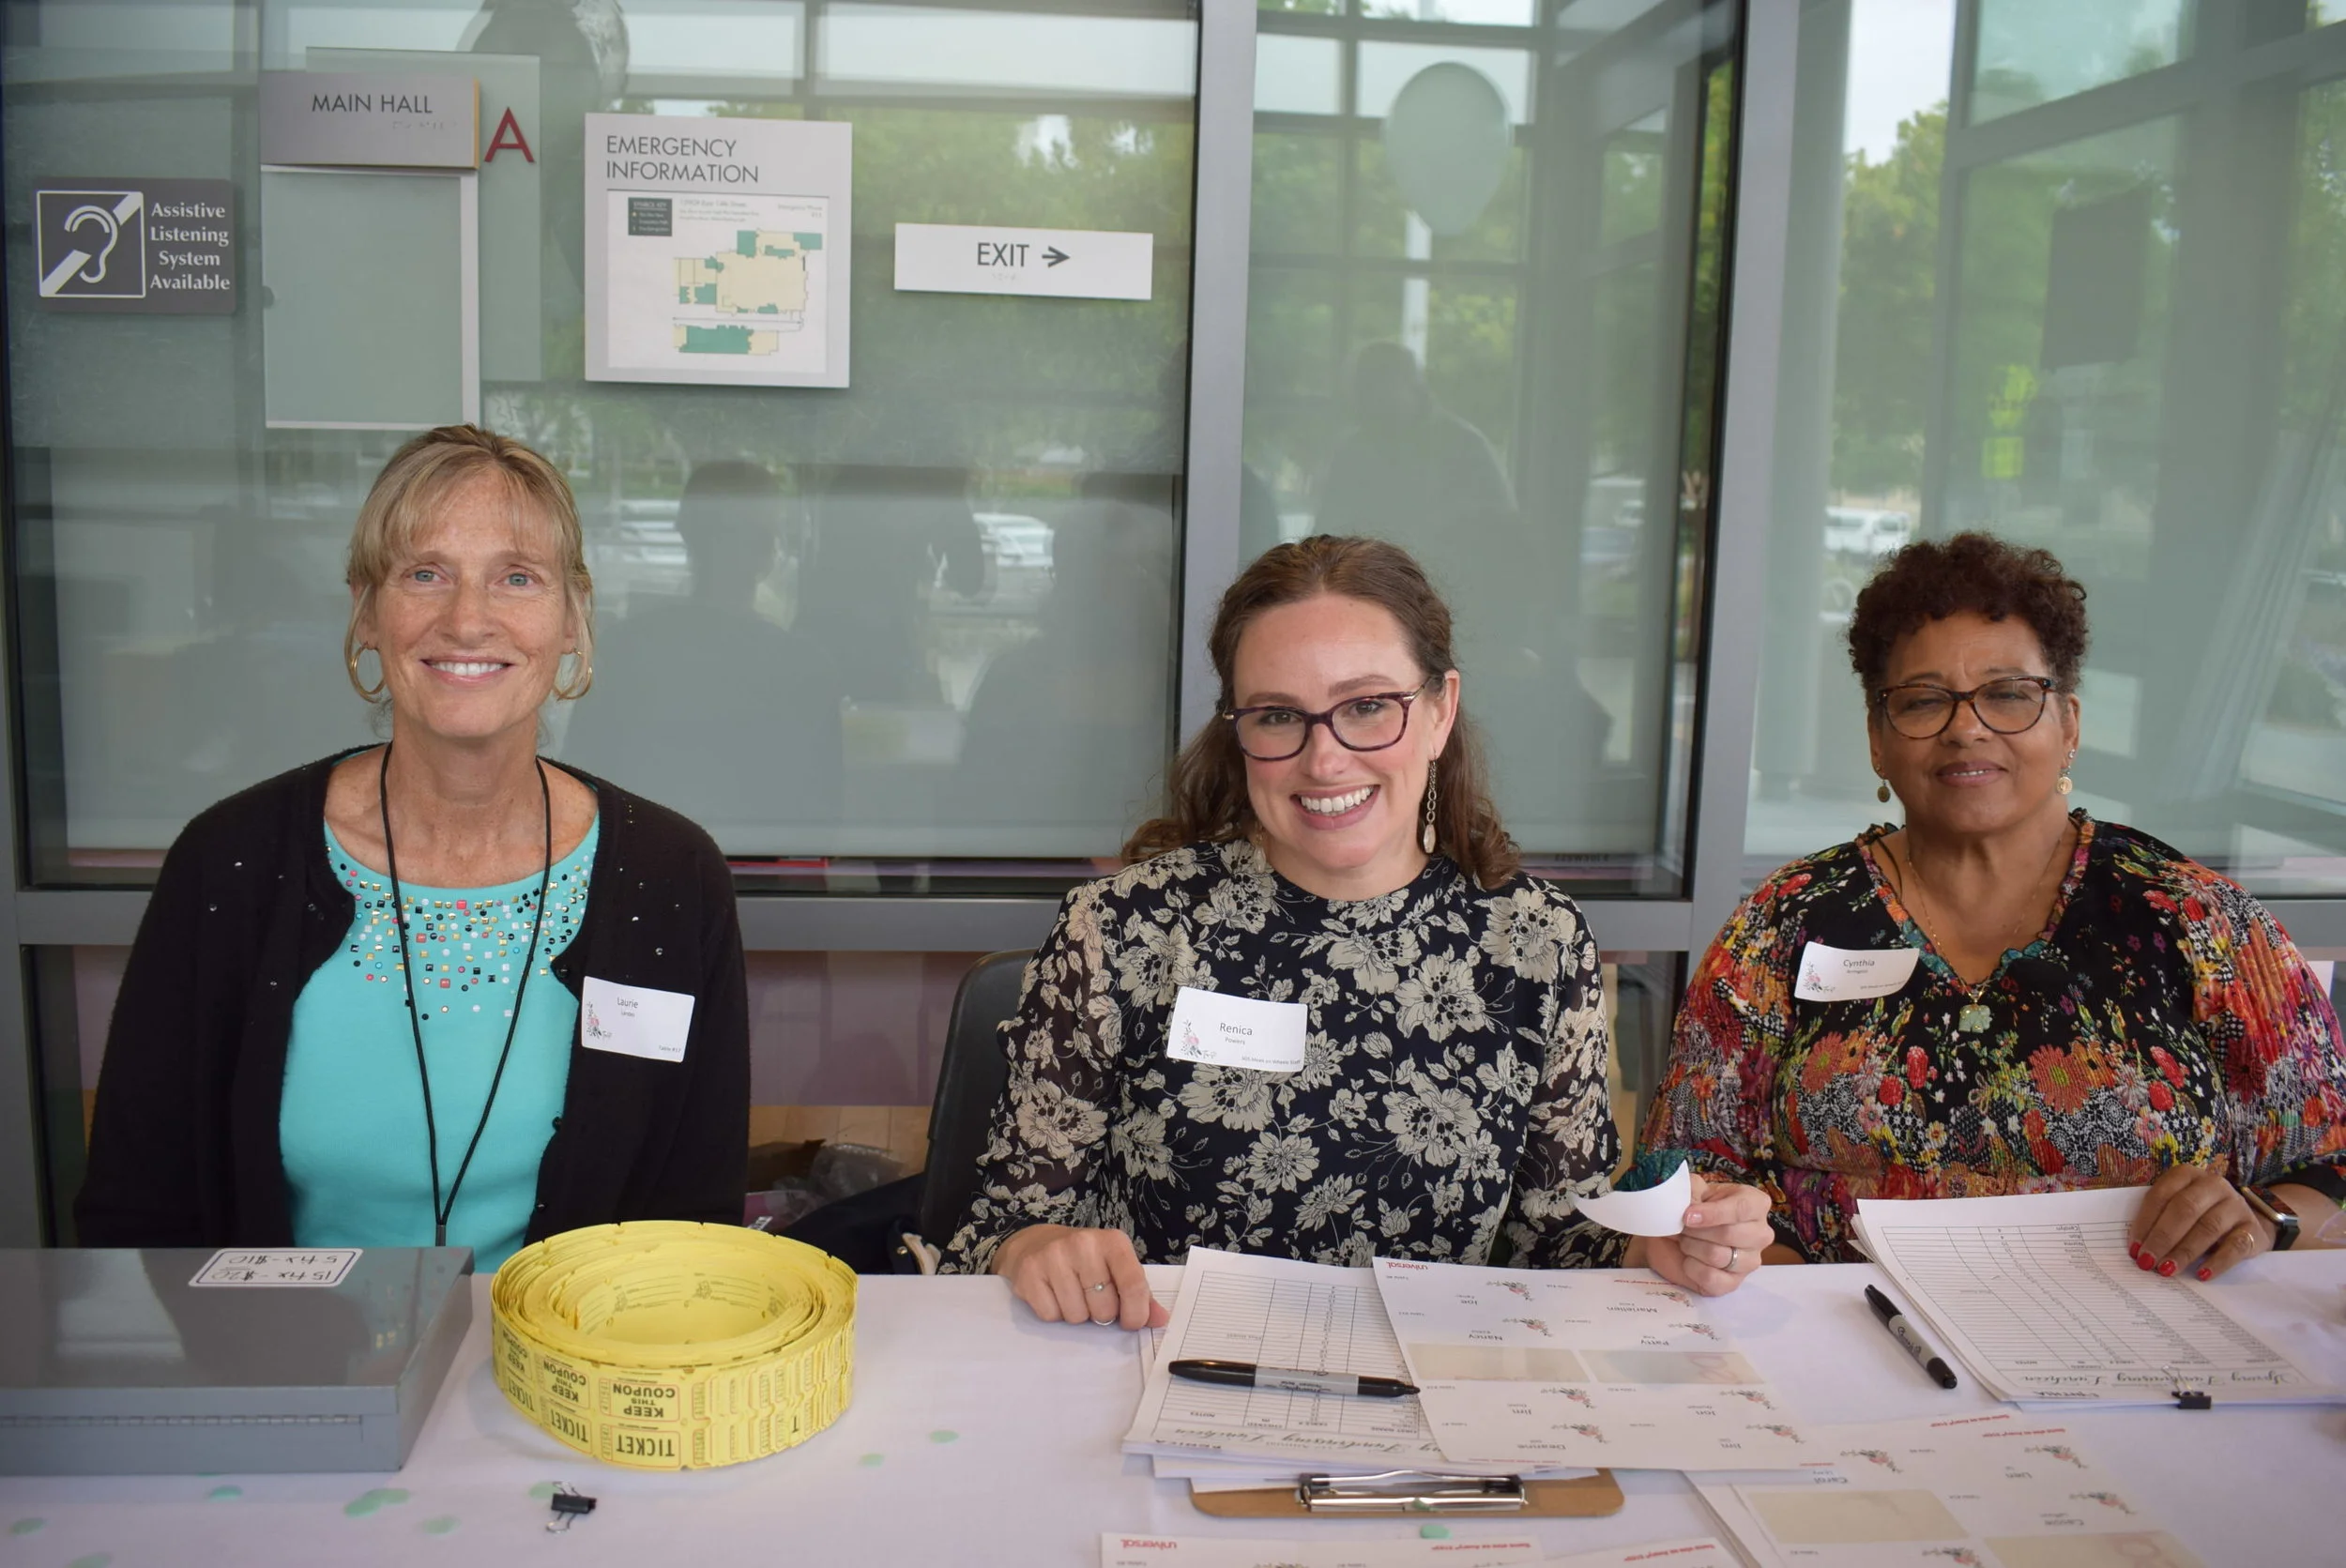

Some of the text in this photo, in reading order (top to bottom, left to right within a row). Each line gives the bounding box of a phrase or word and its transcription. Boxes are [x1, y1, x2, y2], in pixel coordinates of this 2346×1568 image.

[312, 94, 434, 114] MAIN HALL
[484, 107, 535, 162] A
[606, 134, 738, 158] EMERGENCY
[606, 160, 758, 183] INFORMATION
[151, 202, 226, 218] Assistive
[150, 226, 229, 247] Listening
[159, 250, 221, 270] System
[977, 242, 1030, 266] EXIT
[150, 274, 230, 290] Available
[1843, 959, 1875, 968] Cynthia
[617, 997, 639, 1009] Laurie
[1219, 1022, 1253, 1036] Renica
[285, 1256, 316, 1264] tix
[1386, 1261, 1429, 1271] universal
[278, 1272, 306, 1282] tix
[312, 1271, 332, 1280] 15
[543, 1361, 586, 1386] COUPON
[2020, 1374, 2106, 1387] Luncheon
[2231, 1371, 2299, 1386] Spring
[556, 1377, 572, 1389] THIS
[613, 1383, 676, 1398] COUPON
[508, 1377, 535, 1412] TICKET
[552, 1384, 579, 1403] KEEP
[631, 1397, 656, 1406] THIS
[624, 1406, 664, 1418] KEEP
[551, 1409, 588, 1443] TICKET
[1174, 1428, 1274, 1445] Luncheon
[616, 1435, 676, 1457] TICKET
[1813, 1476, 1849, 1485] Carol
[1120, 1539, 1178, 1551] universal
